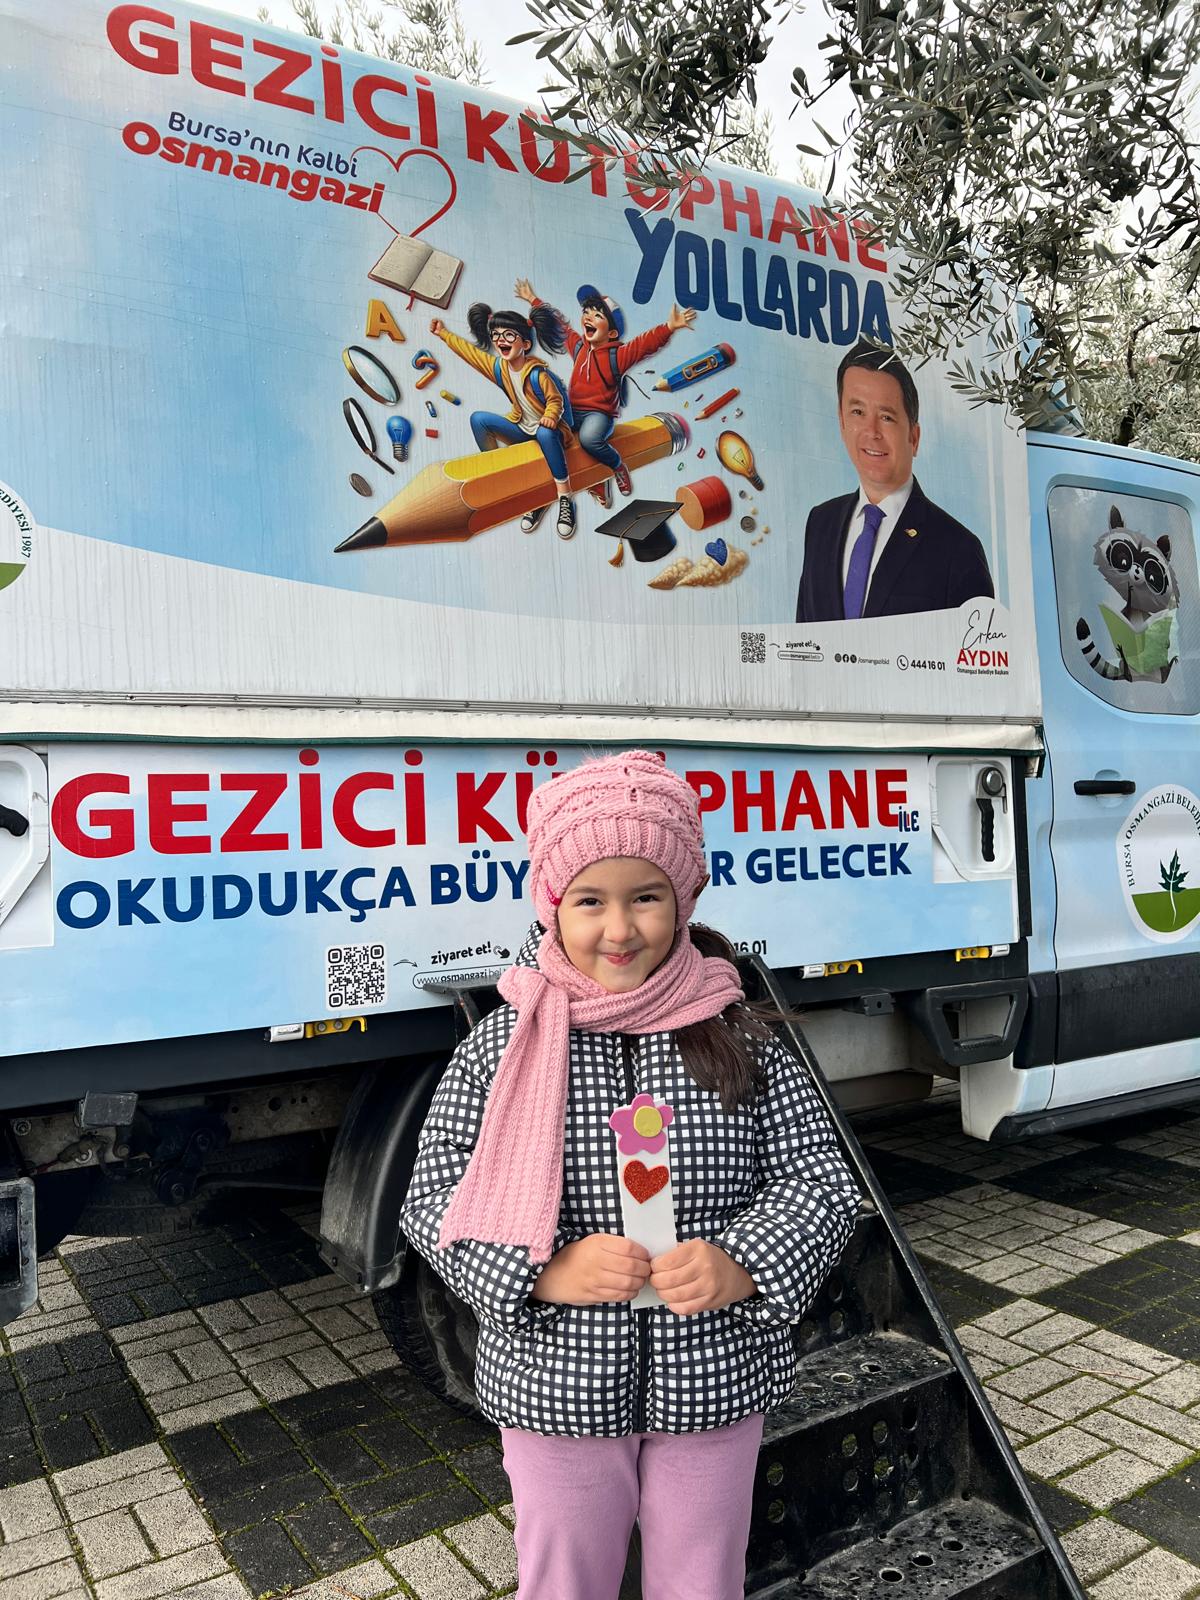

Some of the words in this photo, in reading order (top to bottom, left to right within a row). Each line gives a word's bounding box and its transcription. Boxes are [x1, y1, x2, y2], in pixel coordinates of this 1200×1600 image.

[105, 3, 439, 149] GEZİCİ
[121, 120, 385, 213] Osmangazi
[298, 143, 358, 178] Kalbi
[624, 207, 894, 348] YOLLARDA
[21, 536, 33, 558] 1987
[786, 641, 804, 650] ziyaret
[962, 607, 1006, 650] Erkan
[910, 659, 927, 670] 444
[928, 660, 936, 671] 16
[937, 661, 946, 671] 01
[956, 648, 1009, 668] AYDIN
[51, 749, 427, 859] GEZİCİ
[1125, 789, 1175, 840] OSMANGAZİ
[56, 866, 416, 930] OKUDUKÇA
[745, 842, 912, 885] GELECEK
[1123, 843, 1136, 887] BURSA
[431, 947, 473, 966] ziyaret
[475, 941, 492, 955] et!
[751, 939, 767, 955] 01
